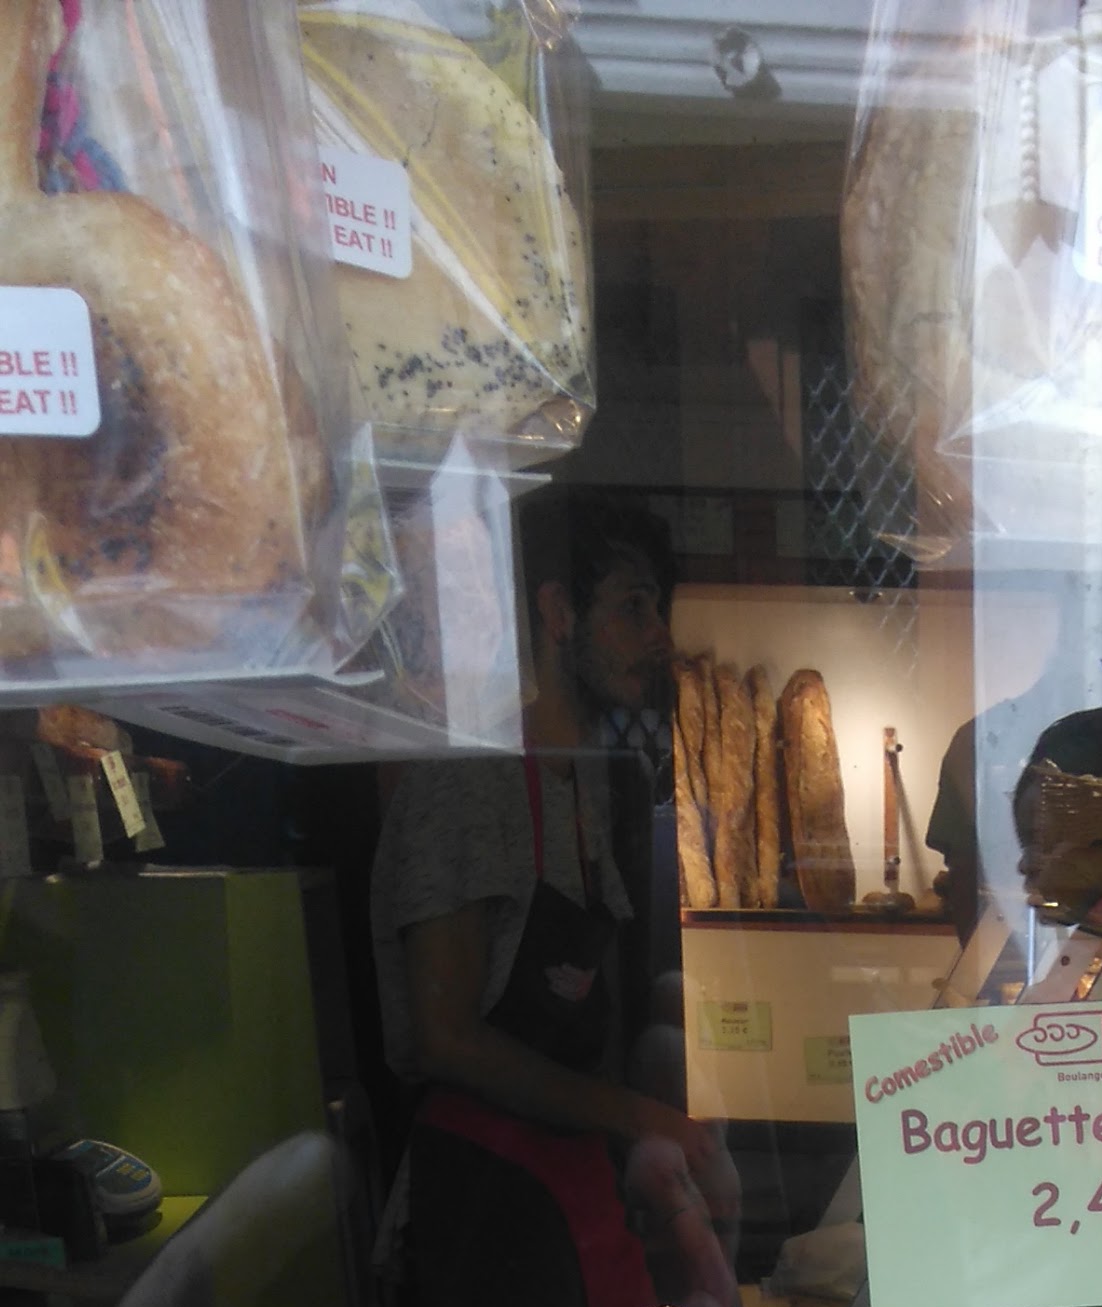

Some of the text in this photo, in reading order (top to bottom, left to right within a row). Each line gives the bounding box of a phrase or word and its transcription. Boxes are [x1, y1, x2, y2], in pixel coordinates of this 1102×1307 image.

[334, 225, 375, 253] EAT
[0, 389, 51, 415] EAT
[864, 1020, 1000, 1104] Comestible
